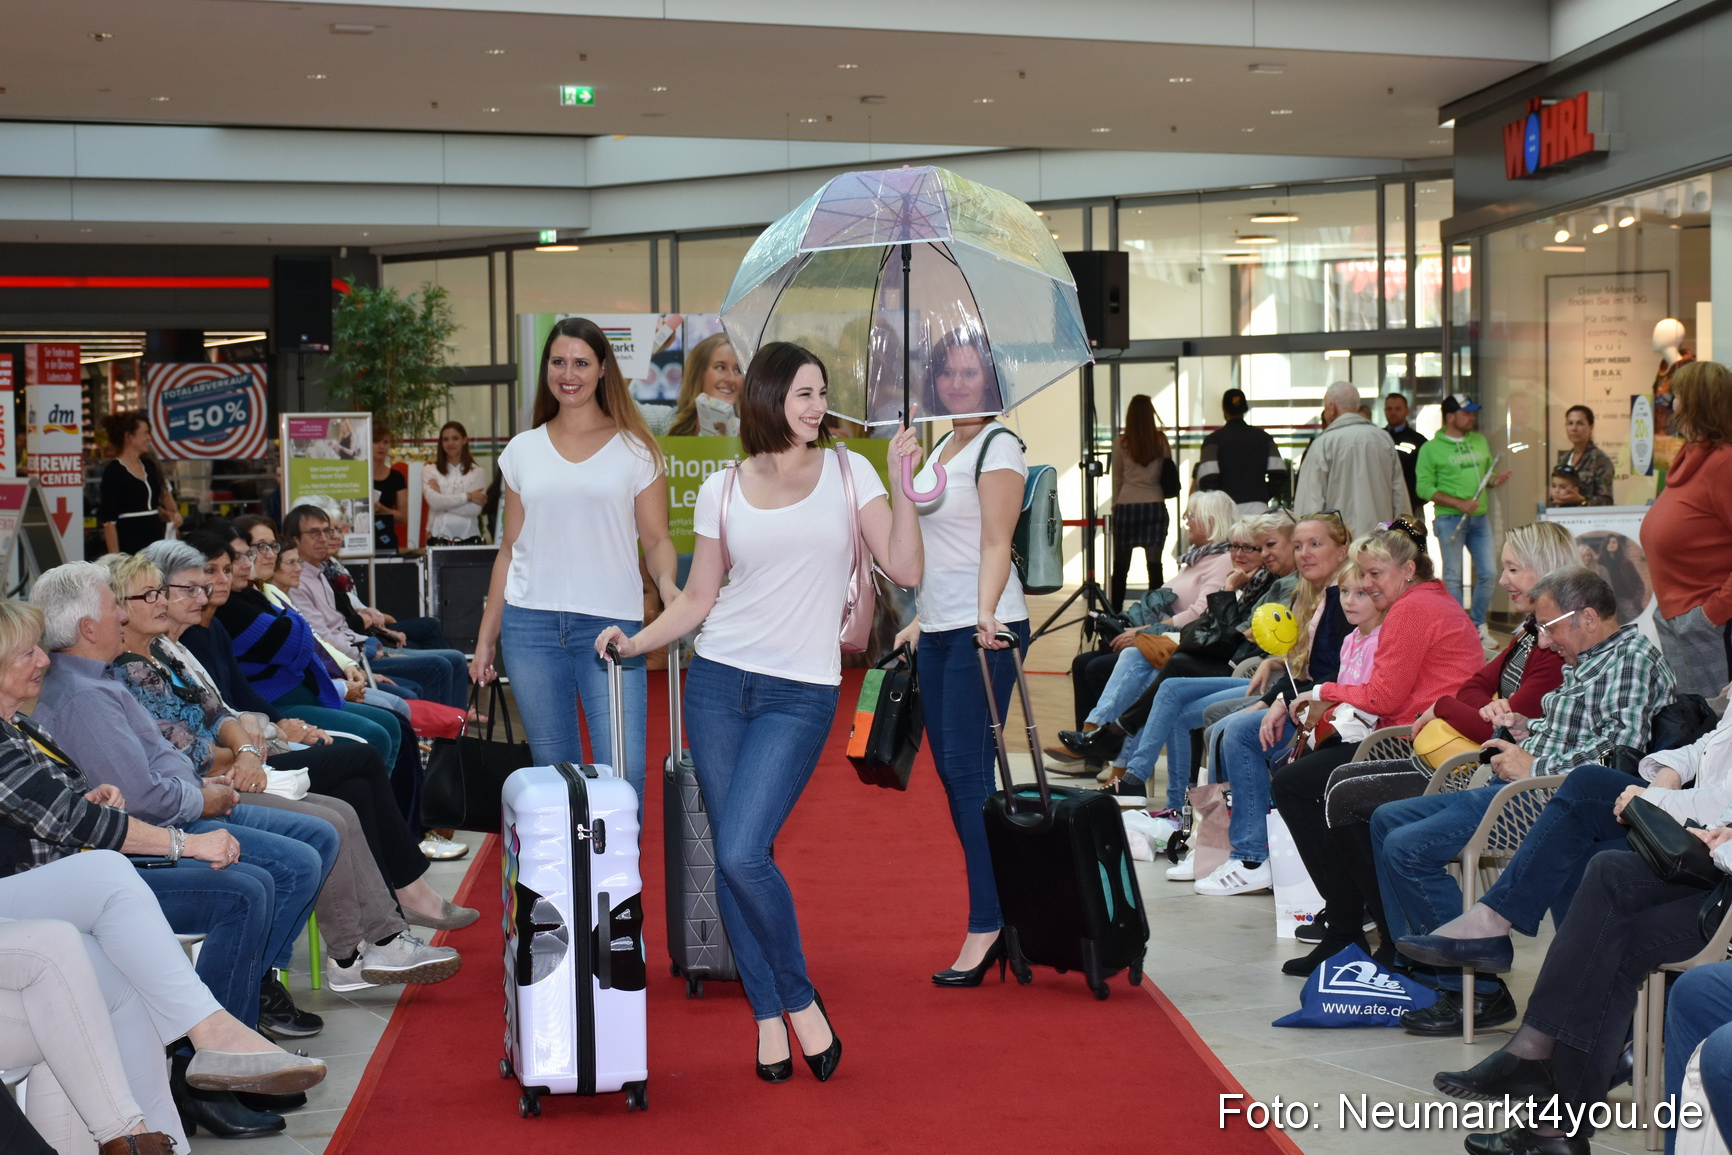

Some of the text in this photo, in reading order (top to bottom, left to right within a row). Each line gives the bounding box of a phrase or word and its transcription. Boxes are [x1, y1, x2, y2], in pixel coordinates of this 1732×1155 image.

[1503, 91, 1595, 181] WÖHRL
[1593, 369, 1622, 377] BRAX
[163, 375, 249, 399] TOTALABVERKAUF
[48, 403, 75, 424] dm
[41, 455, 82, 472] REWE
[665, 453, 740, 482] hopp
[41, 473, 82, 485] CENTER
[670, 485, 702, 508] Le
